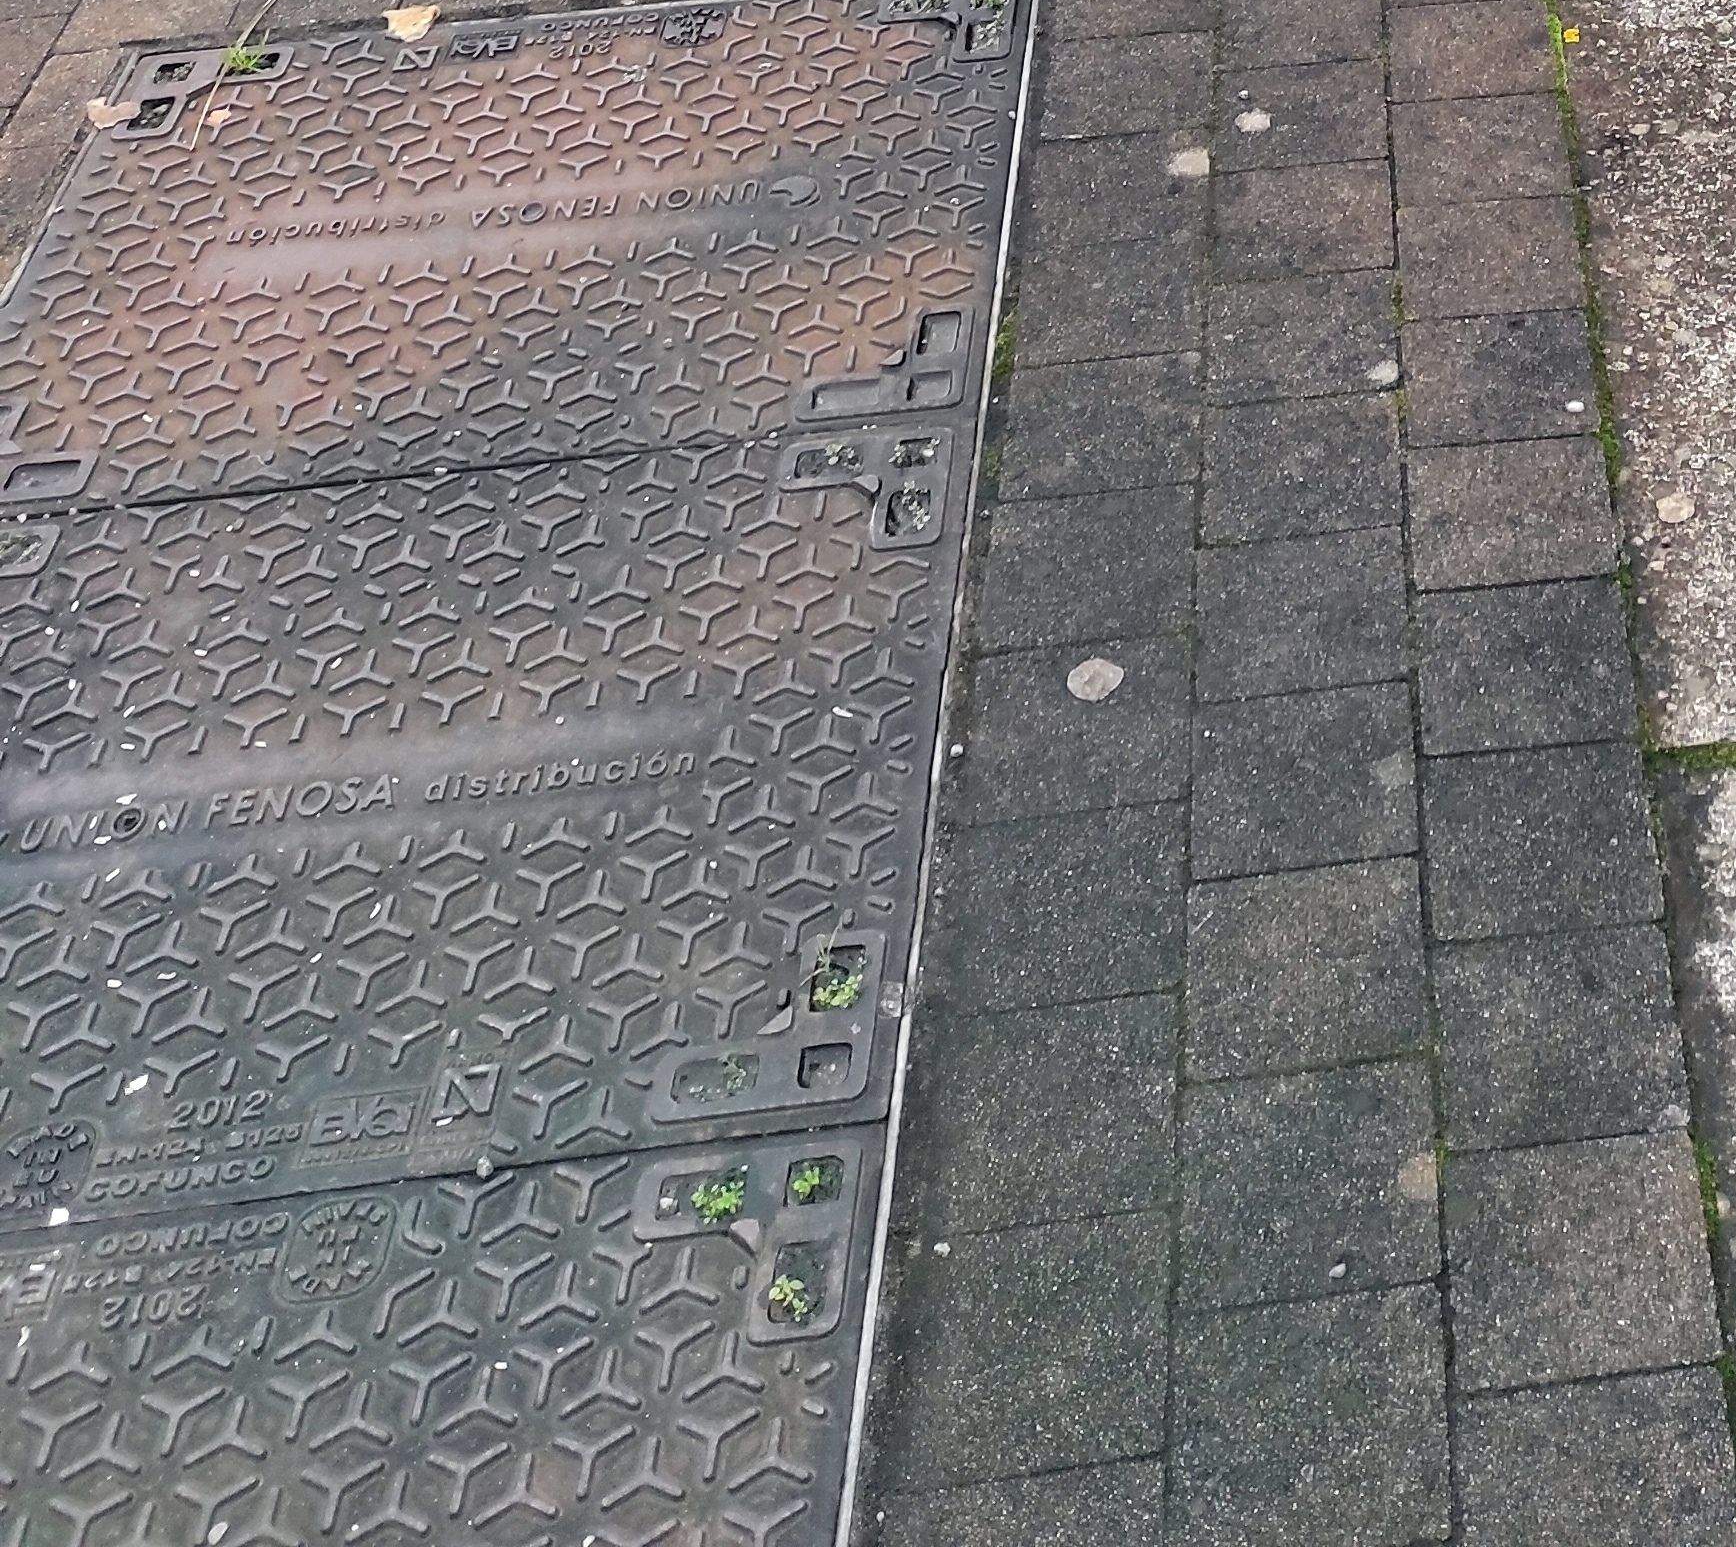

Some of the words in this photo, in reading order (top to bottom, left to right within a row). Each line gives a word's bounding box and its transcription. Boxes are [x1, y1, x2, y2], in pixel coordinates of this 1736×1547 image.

[549, 41, 613, 59] 2012
[226, 212, 446, 247] distribución
[471, 194, 618, 228] FENOSA
[203, 773, 395, 831] FENOSA
[424, 749, 697, 804] distribución
[166, 1089, 272, 1134] 2012
[84, 1155, 276, 1202] COFUNCO
[101, 1281, 208, 1331] 2012
